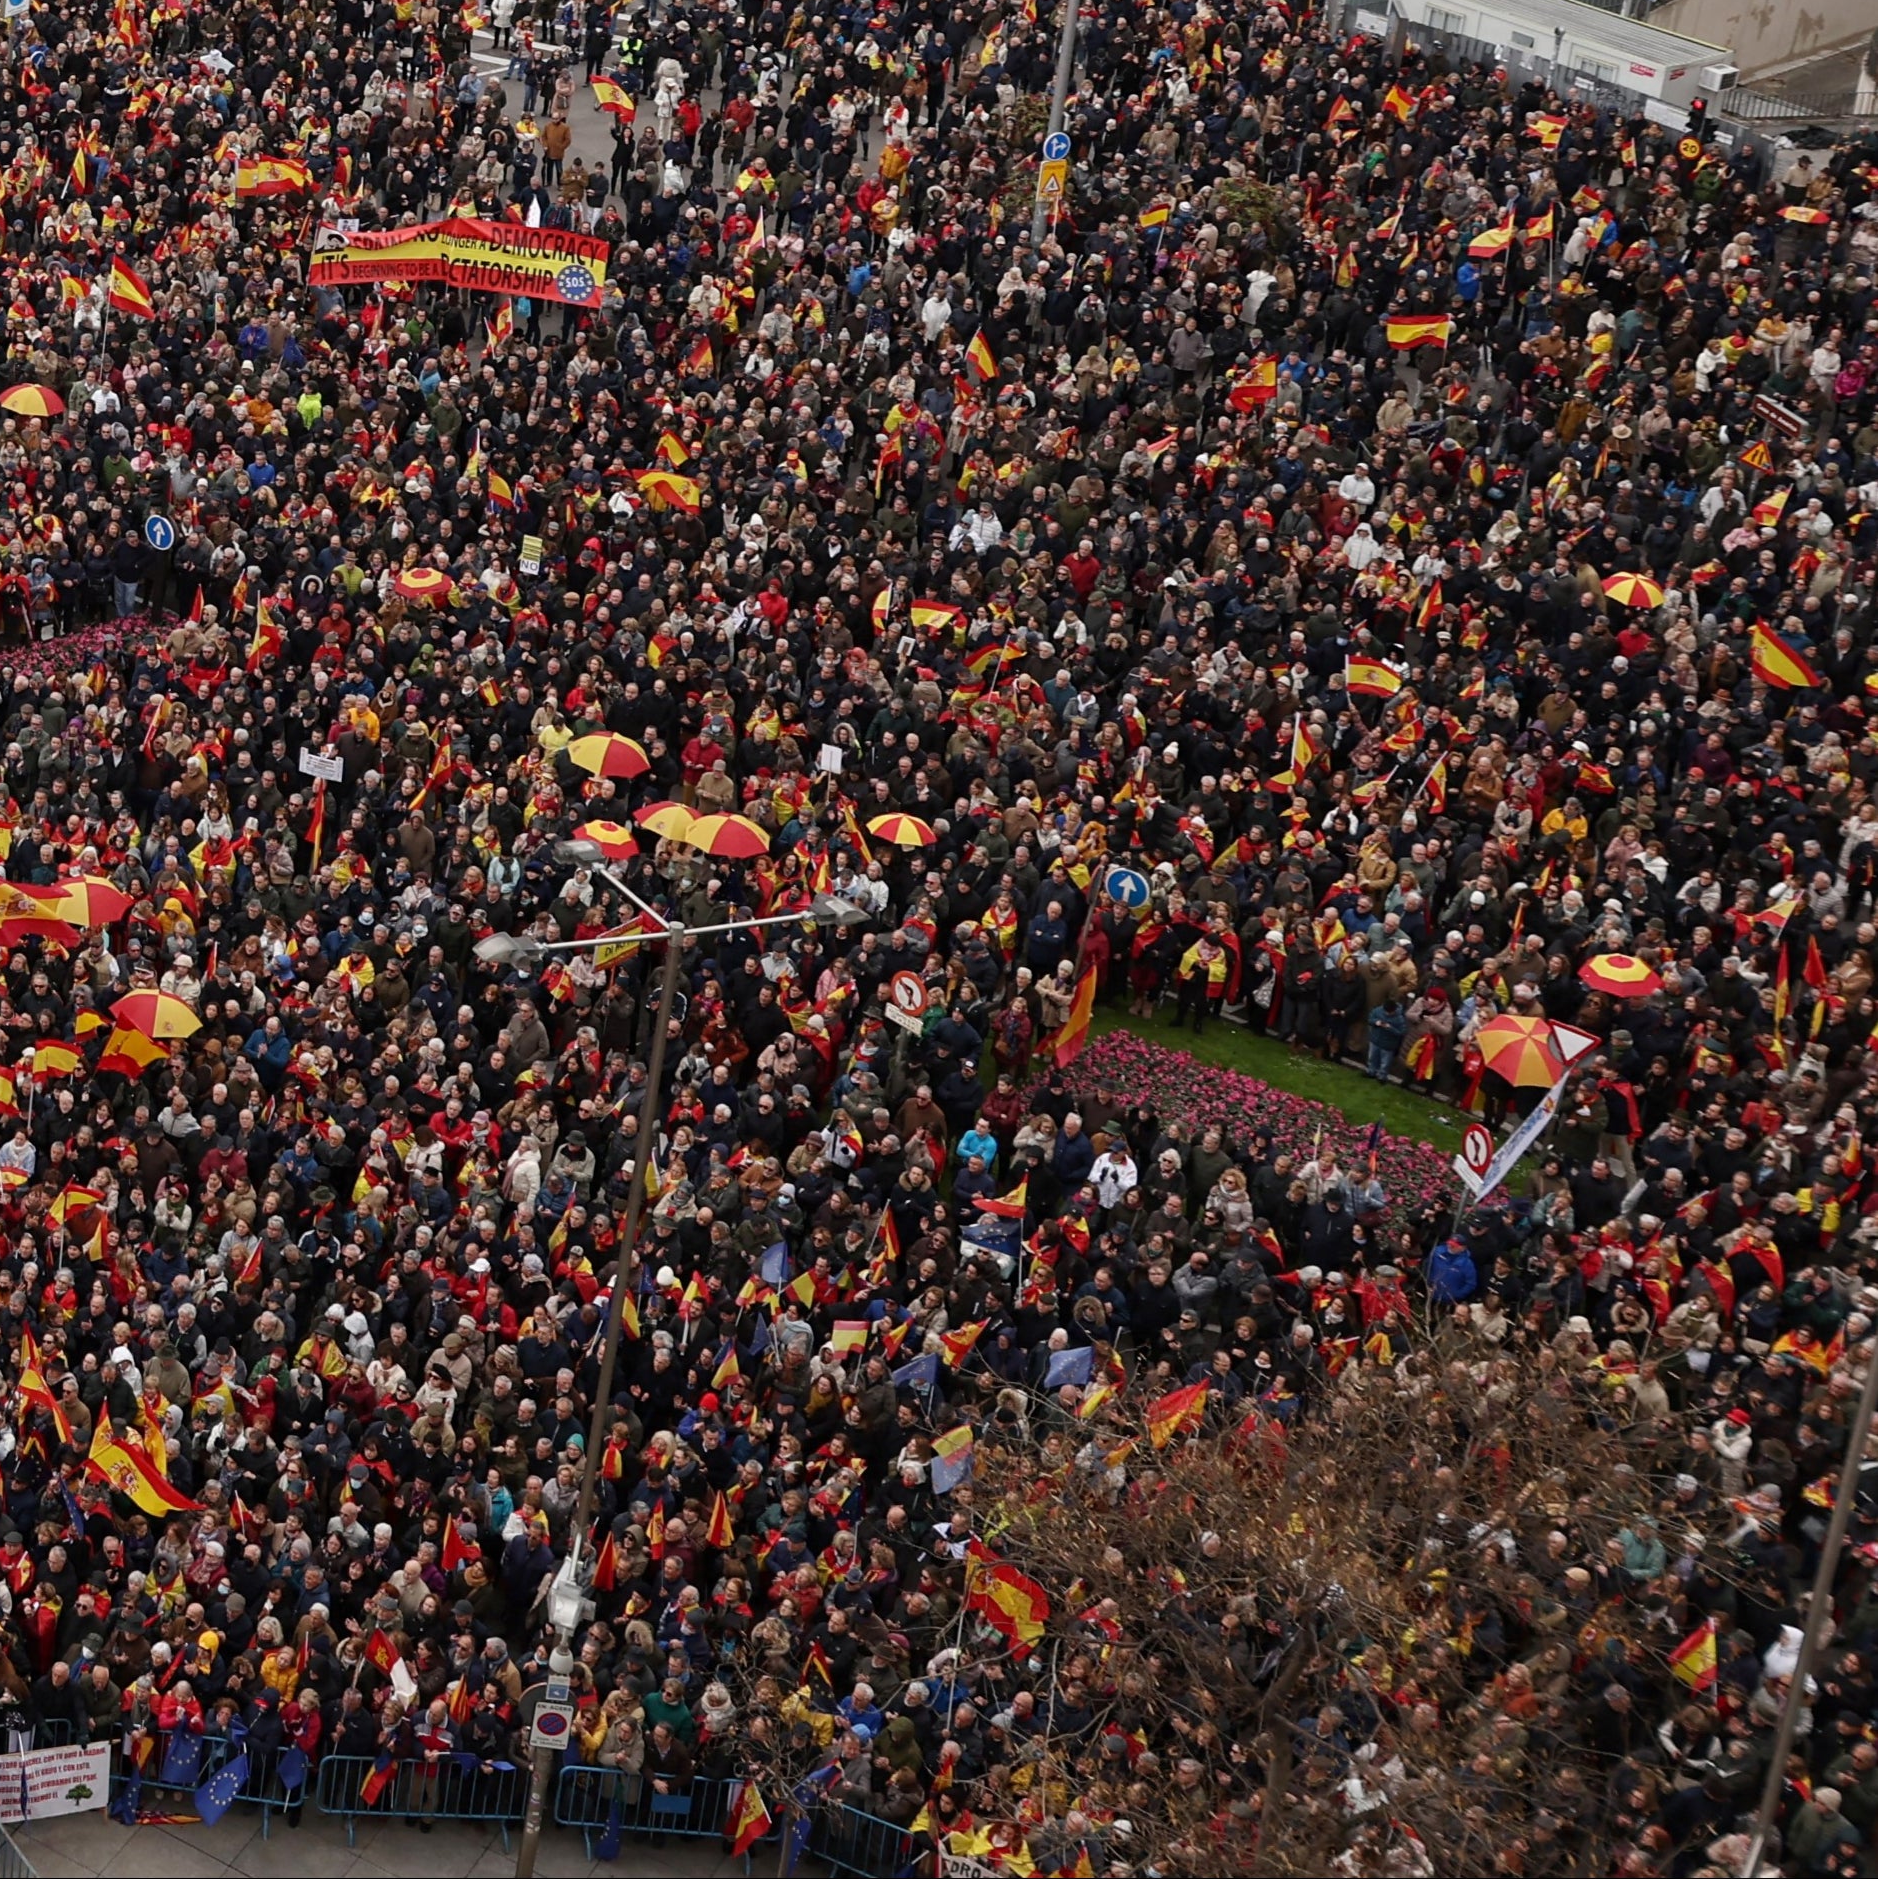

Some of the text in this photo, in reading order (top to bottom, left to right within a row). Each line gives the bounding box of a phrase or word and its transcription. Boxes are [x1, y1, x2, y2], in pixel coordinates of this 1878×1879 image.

[1683, 142, 1697, 154] 20
[414, 227, 439, 243] NO
[441, 229, 477, 249] LONGER
[479, 239, 486, 251] A
[489, 227, 600, 268] DEMOCRACY
[321, 253, 349, 280] IT'S
[352, 263, 402, 278] BEGINNING
[402, 263, 417, 277] TO
[419, 263, 431, 276] BE
[432, 263, 439, 277] A
[521, 559, 538, 572] NO
[63, 1764, 76, 1772] CON
